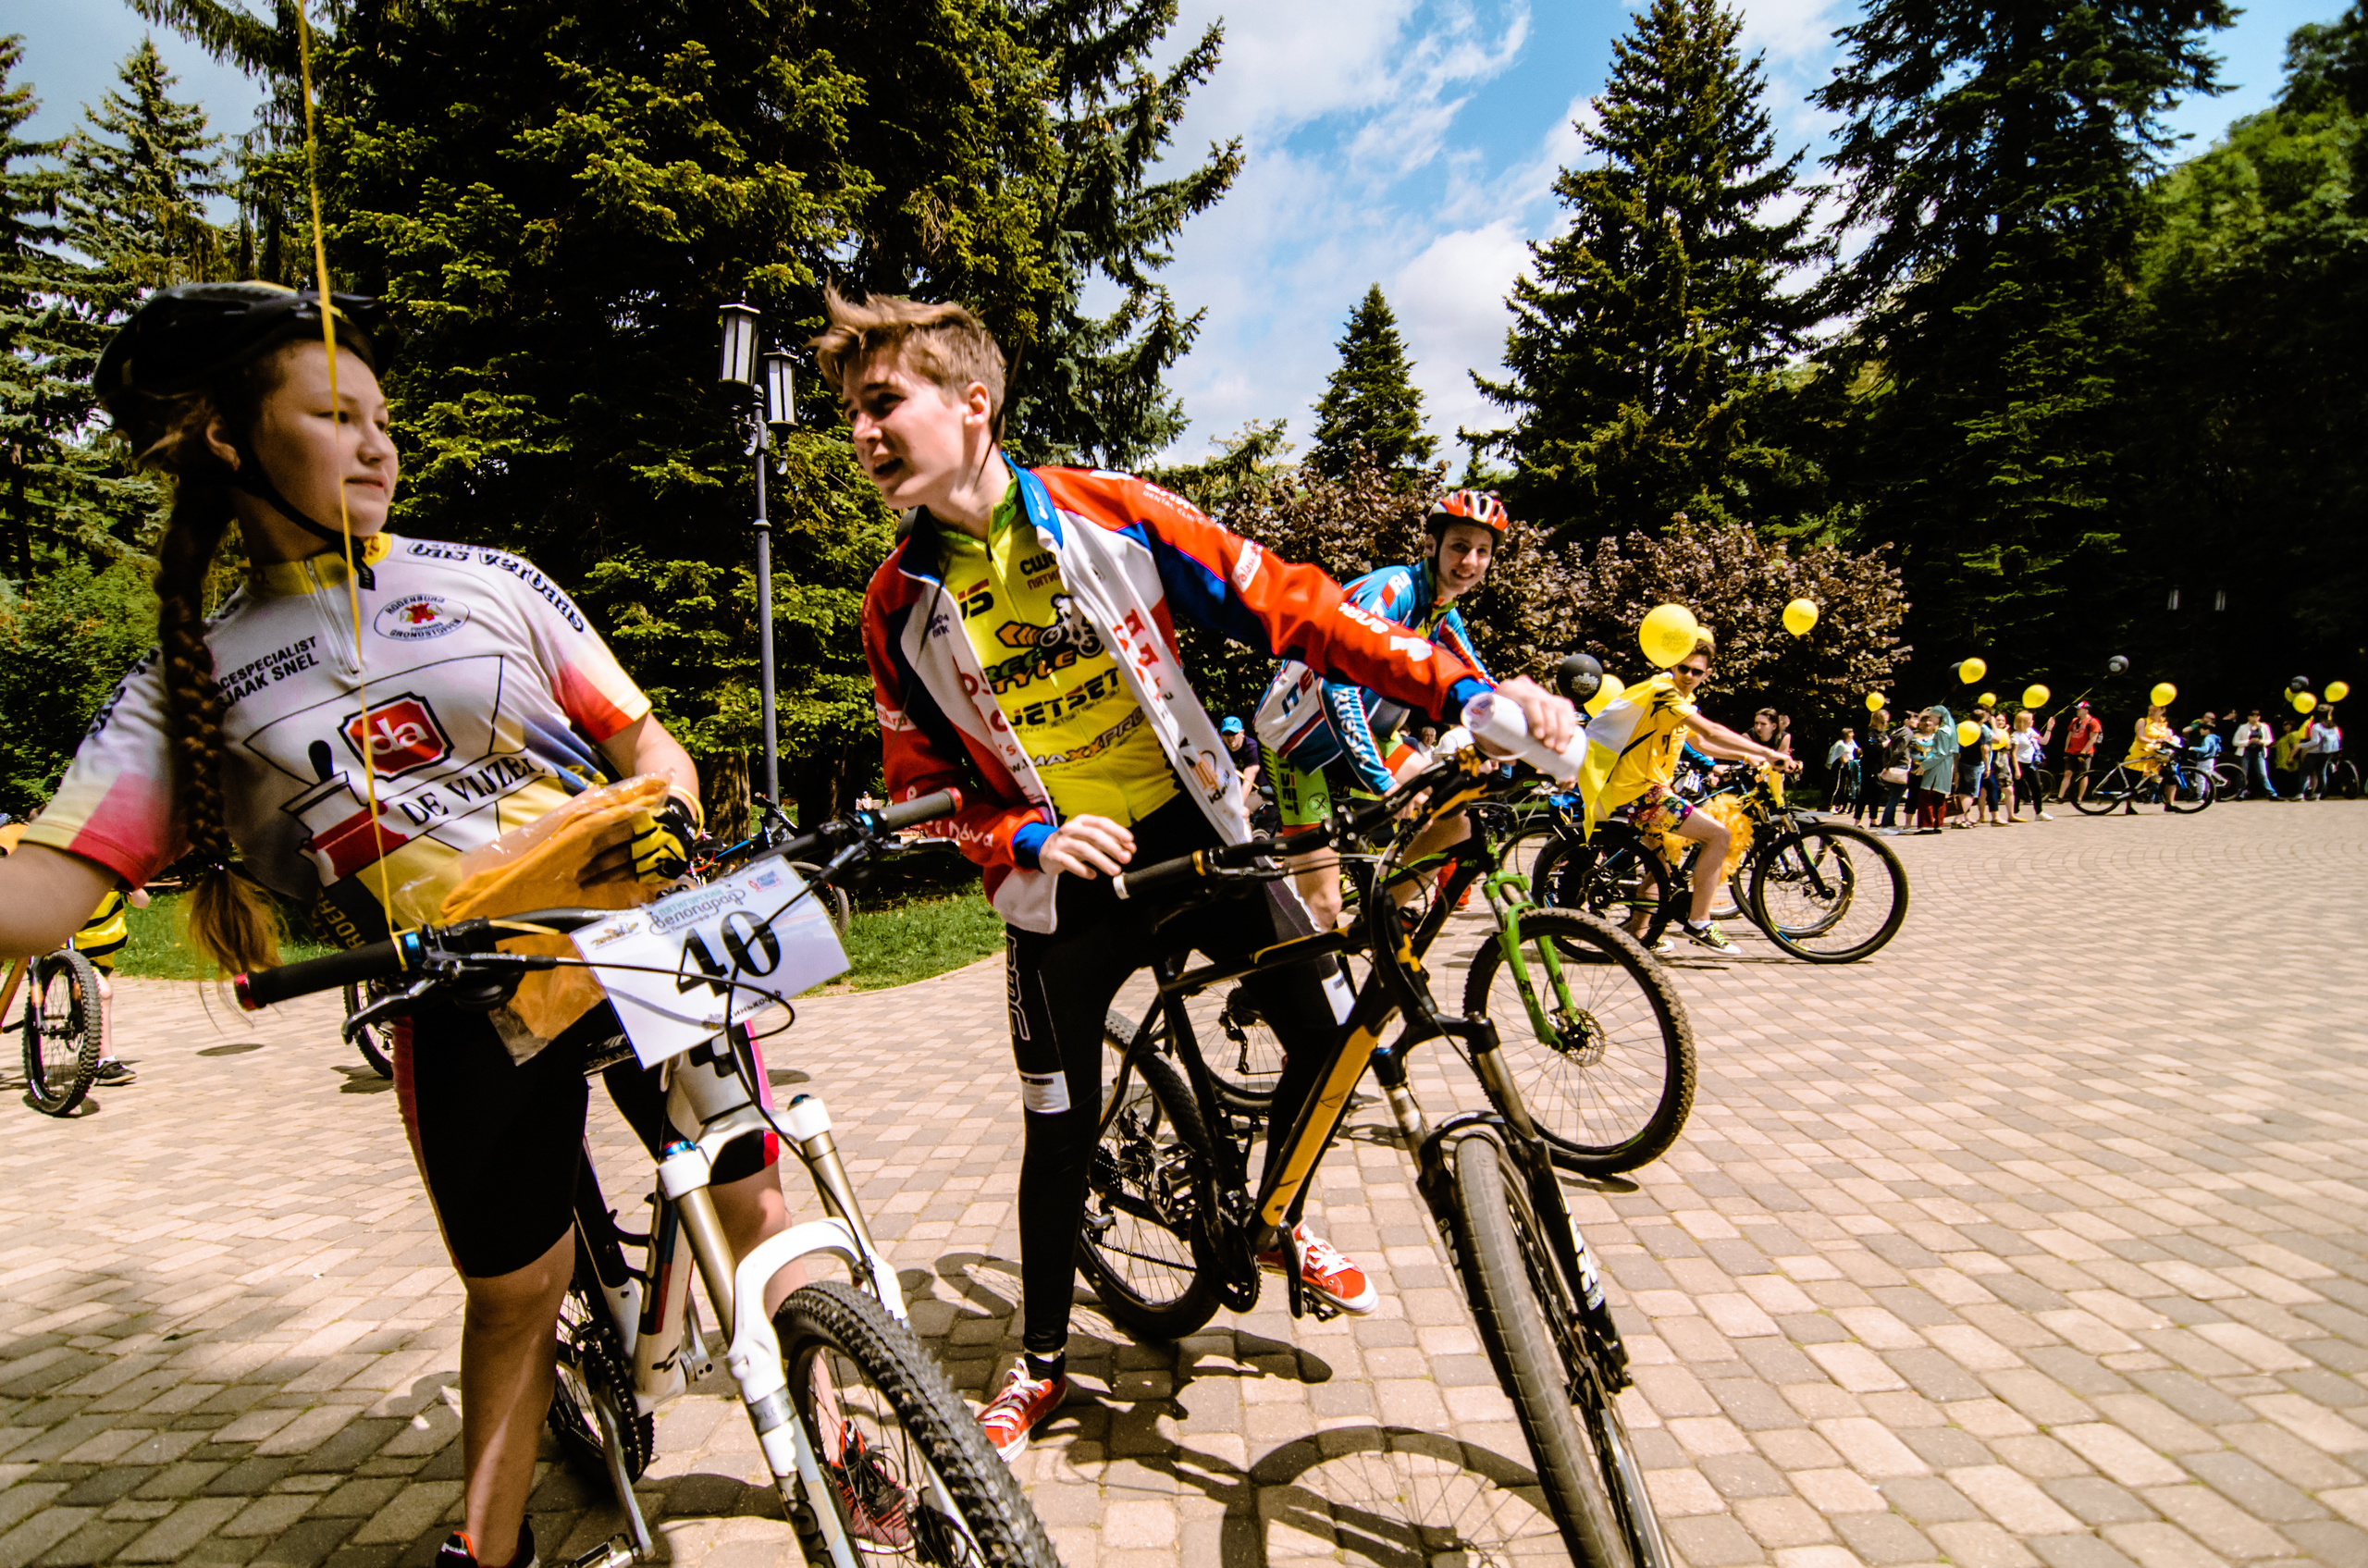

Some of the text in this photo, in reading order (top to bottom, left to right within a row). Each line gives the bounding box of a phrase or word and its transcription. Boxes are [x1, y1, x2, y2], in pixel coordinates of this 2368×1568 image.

[478, 551, 585, 633] verbaas
[271, 652, 319, 682] SNEL
[1009, 668, 1118, 726] JETSET
[398, 757, 546, 826] DE VIJZEL
[675, 910, 781, 998] 40
